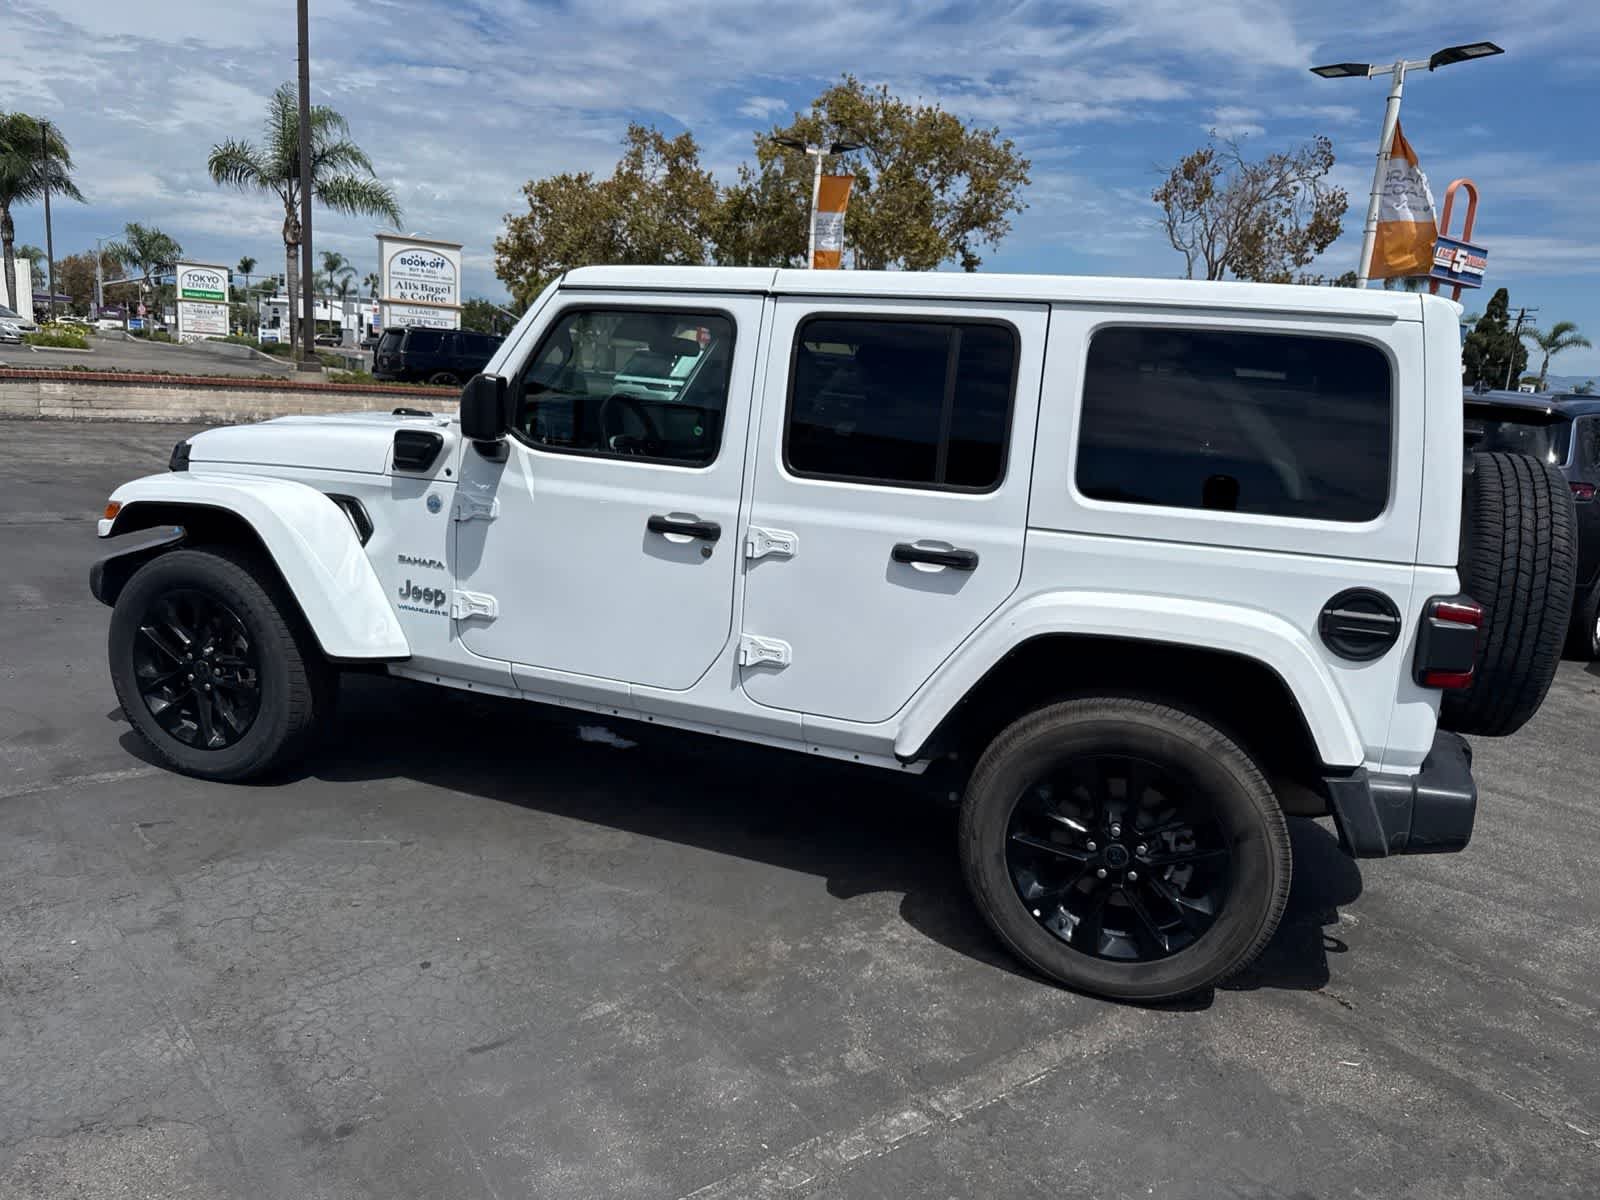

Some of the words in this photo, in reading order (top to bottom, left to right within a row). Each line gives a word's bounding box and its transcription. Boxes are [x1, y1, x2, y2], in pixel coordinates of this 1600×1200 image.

[1452, 249, 1467, 273] 5
[187, 274, 219, 284] TOKYO
[187, 282, 219, 290] CENTRAL
[421, 283, 451, 295] Bagel
[400, 291, 408, 300] &
[411, 292, 447, 303] Coffee
[408, 308, 440, 316] CLEANERS
[398, 555, 445, 570] SAHARA
[399, 580, 446, 608] Jeep
